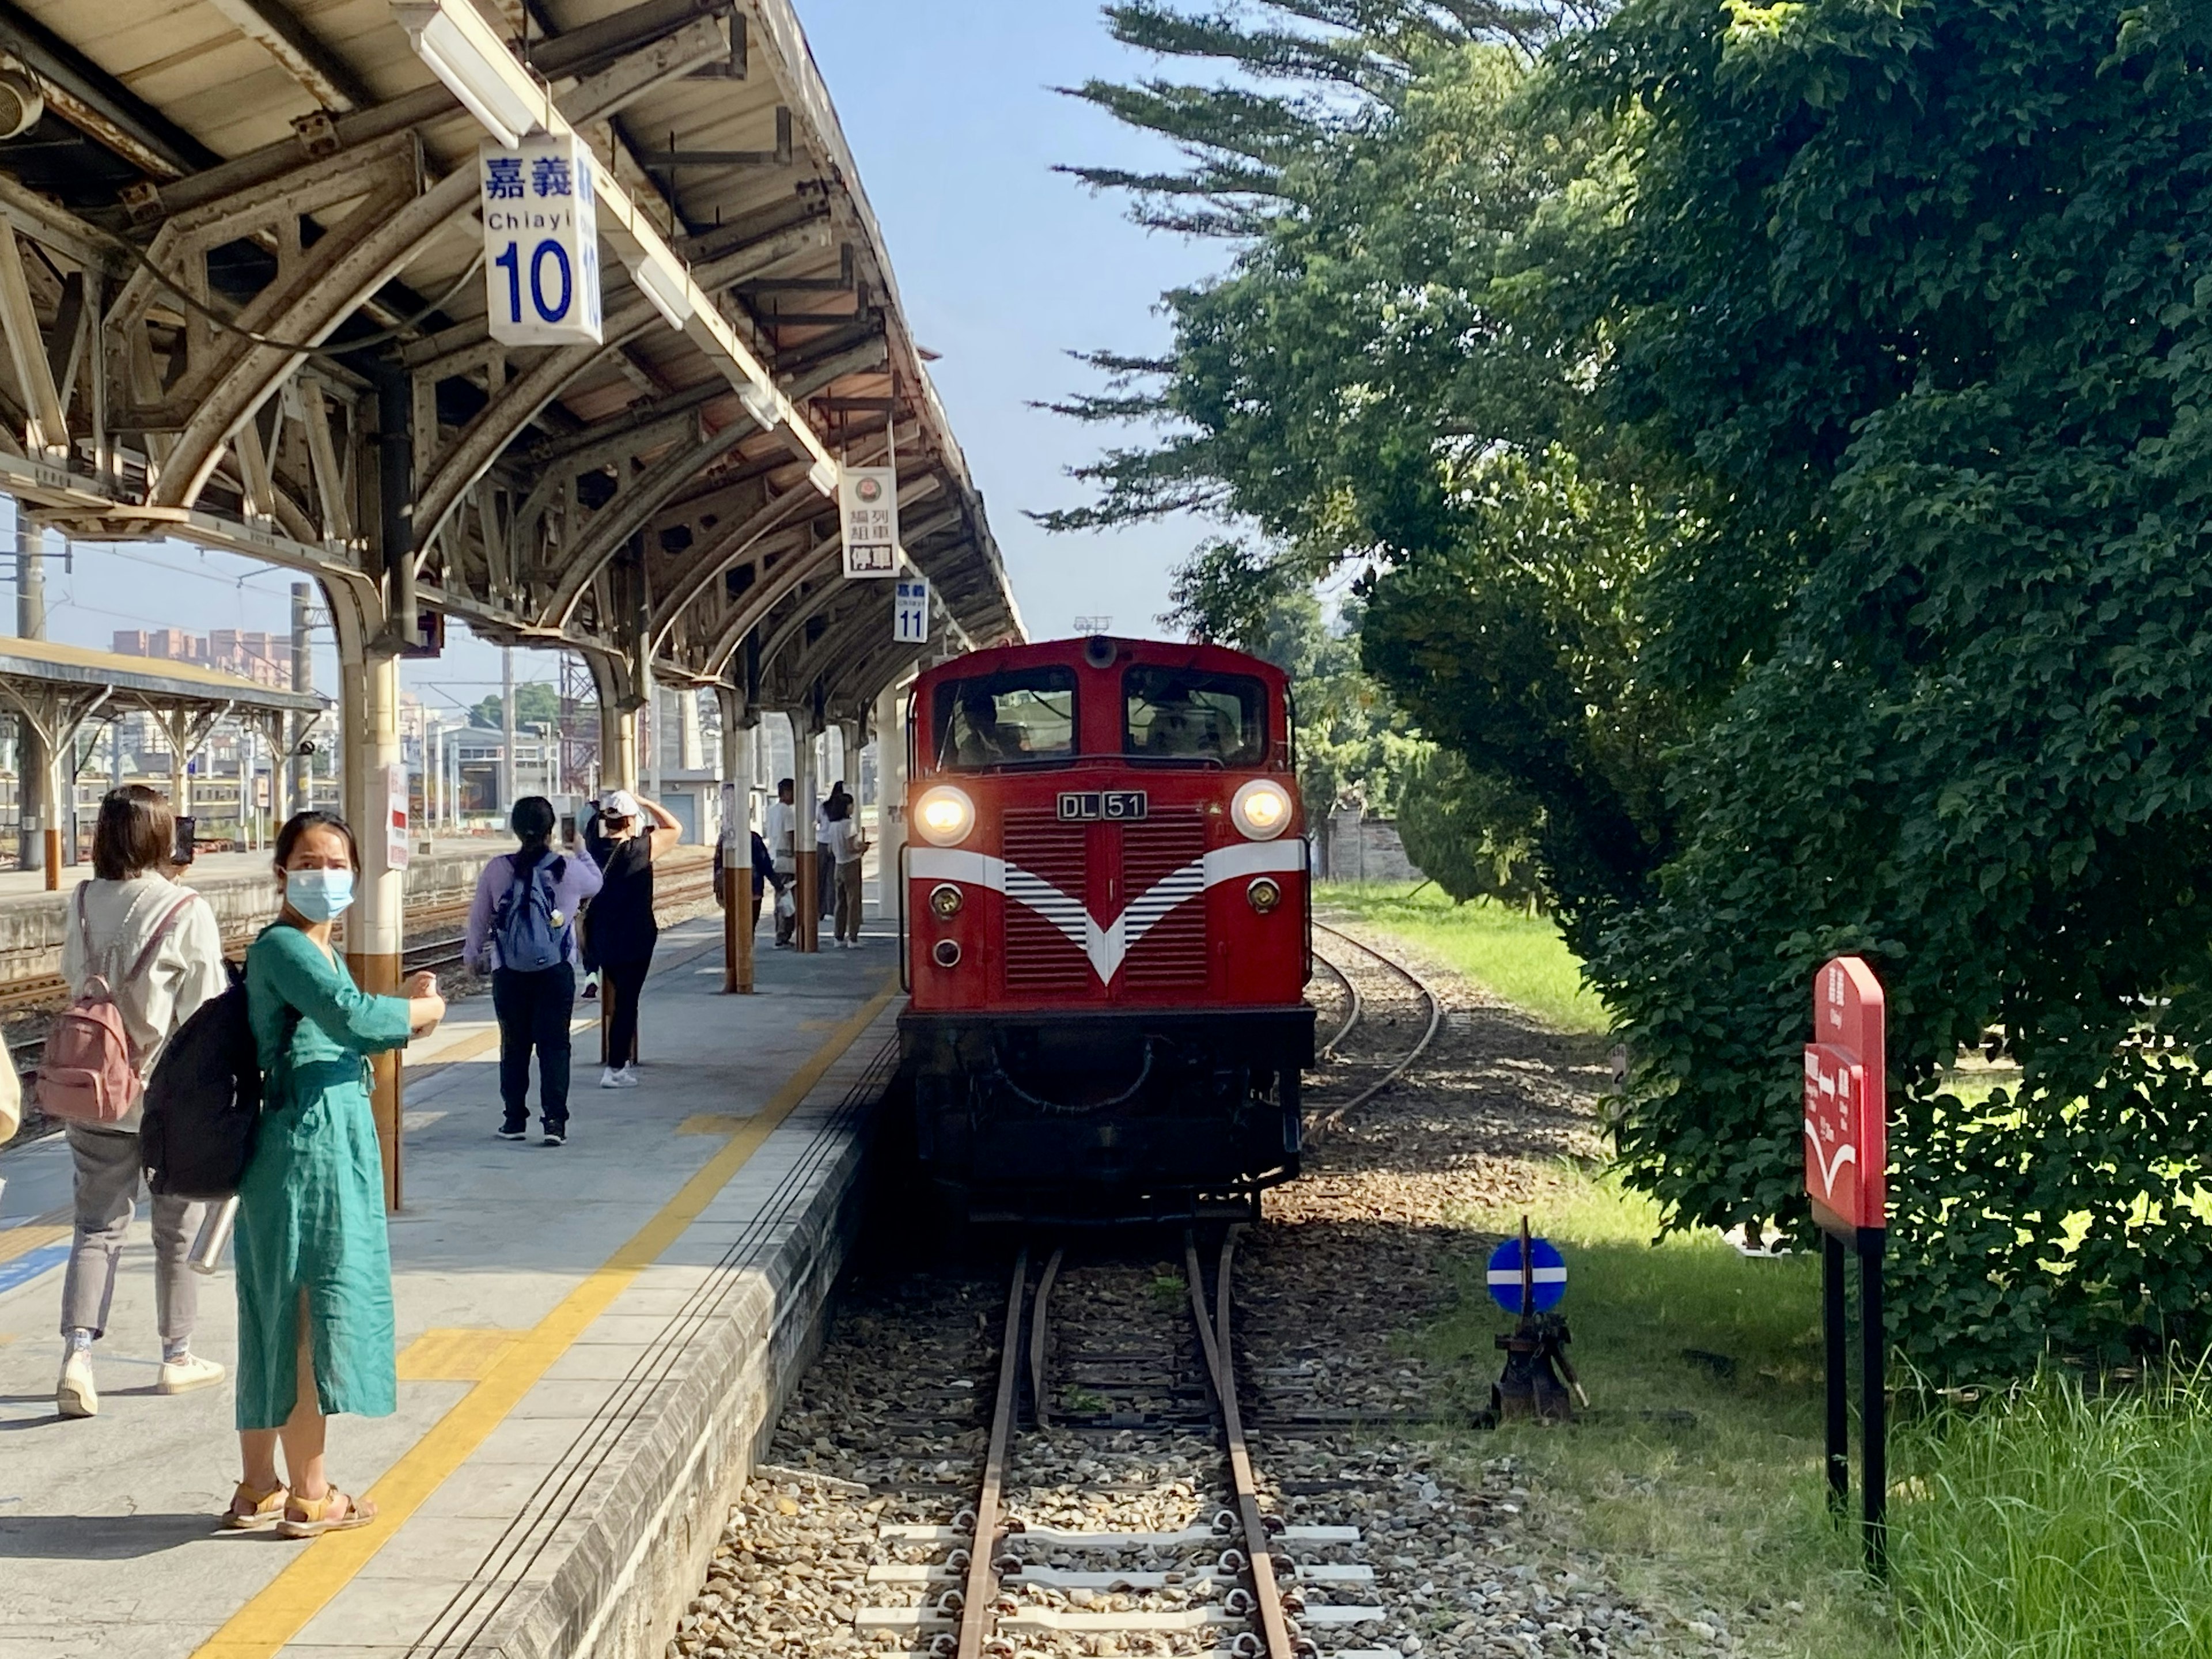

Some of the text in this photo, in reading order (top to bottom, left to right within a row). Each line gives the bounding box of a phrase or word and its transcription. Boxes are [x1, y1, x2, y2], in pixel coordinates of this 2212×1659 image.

[486, 156, 572, 199] 嘉義
[488, 209, 570, 230] Chiayi
[495, 238, 571, 323] 10
[900, 610, 921, 637] 11
[1063, 795, 1138, 817] DL 51
